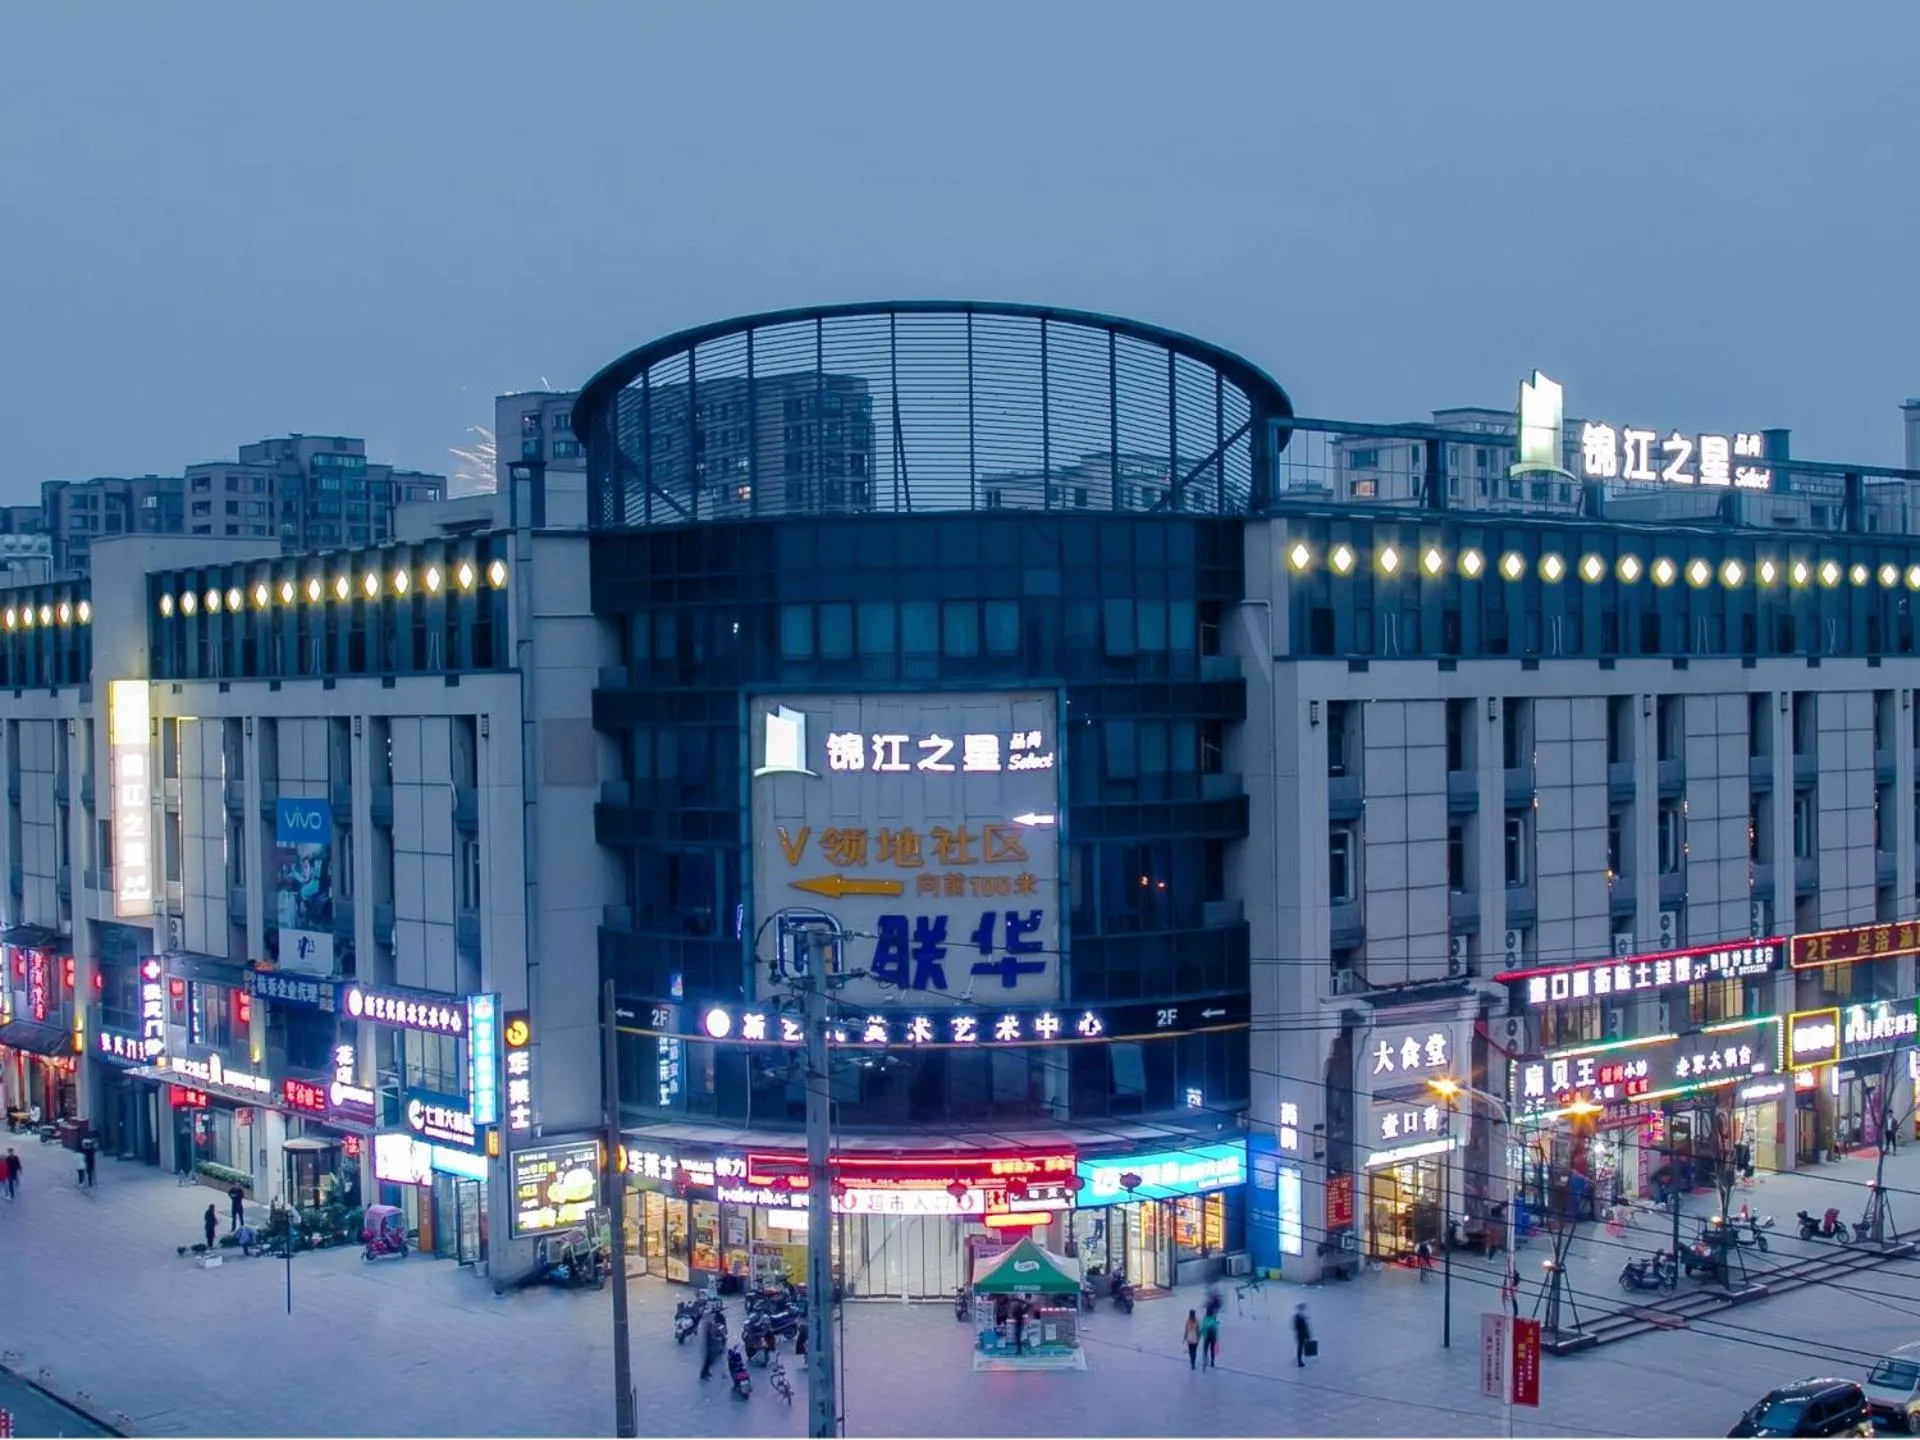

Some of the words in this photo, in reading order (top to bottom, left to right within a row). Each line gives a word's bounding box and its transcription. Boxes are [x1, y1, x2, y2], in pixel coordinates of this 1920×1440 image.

[1582, 421, 1731, 486] 锦江之星
[826, 732, 1002, 772] 锦江之星
[1007, 752, 1054, 771] Select
[916, 871, 1039, 898] 向前100米
[870, 909, 1047, 990] 联华
[652, 1008, 669, 1027] 2F
[743, 1010, 1103, 1044] 新艺美术艺术中心
[1156, 1008, 1178, 1028] 2F
[1373, 1033, 1448, 1075] 大食堂
[508, 1051, 530, 1130] 华莱士
[628, 1150, 677, 1181] 华莱士
[867, 1193, 951, 1213] 超市入口
